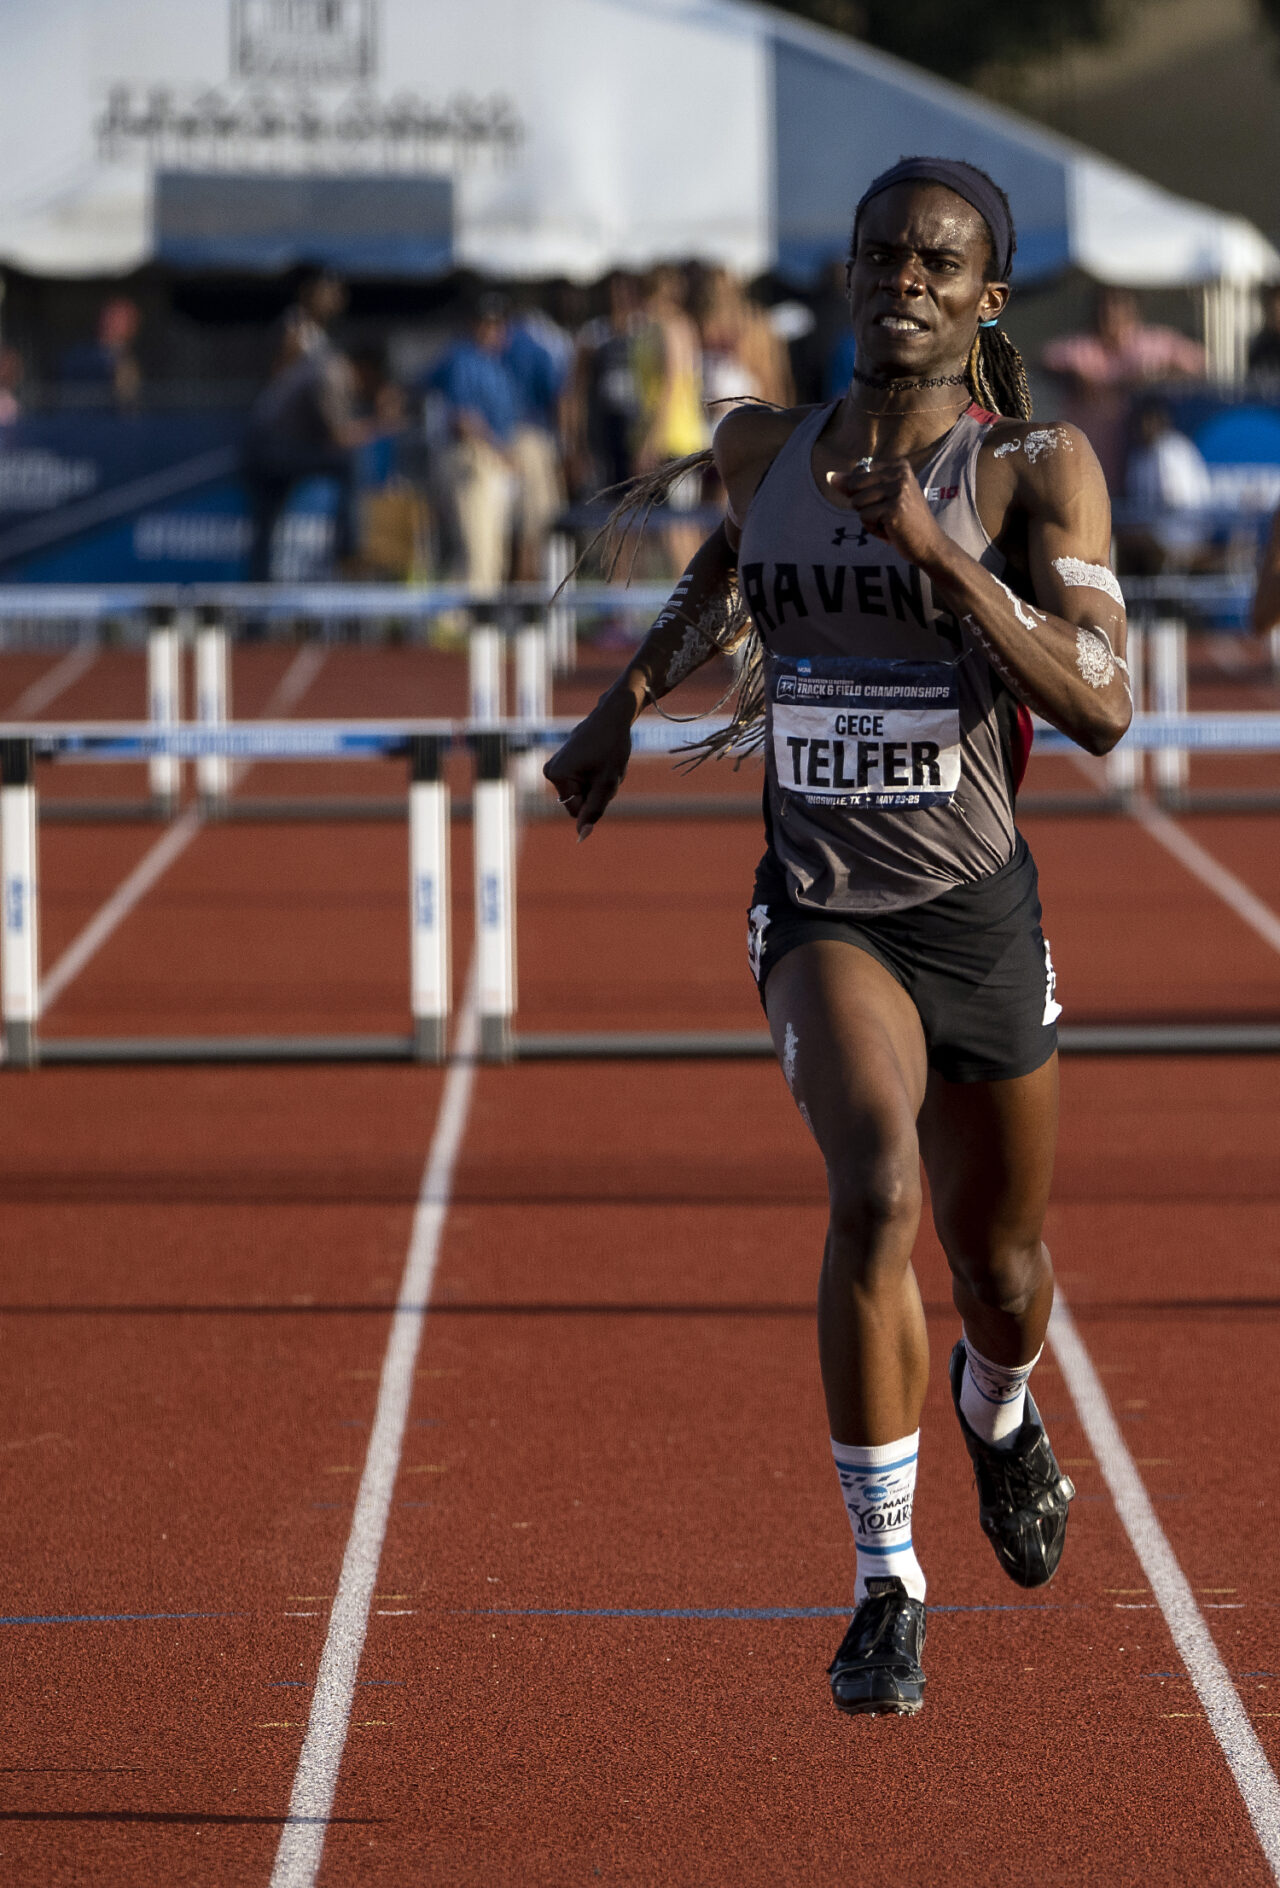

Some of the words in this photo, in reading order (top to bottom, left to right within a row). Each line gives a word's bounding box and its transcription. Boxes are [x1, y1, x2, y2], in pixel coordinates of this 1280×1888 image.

[798, 683, 826, 695] TRACK
[827, 685, 835, 696] &
[836, 685, 862, 696] FIELD
[864, 685, 950, 698] CHAMPIONSHIPS
[835, 714, 884, 736] CECE
[787, 736, 941, 788] TELFER
[850, 795, 861, 805] TX
[876, 795, 894, 805] MAY
